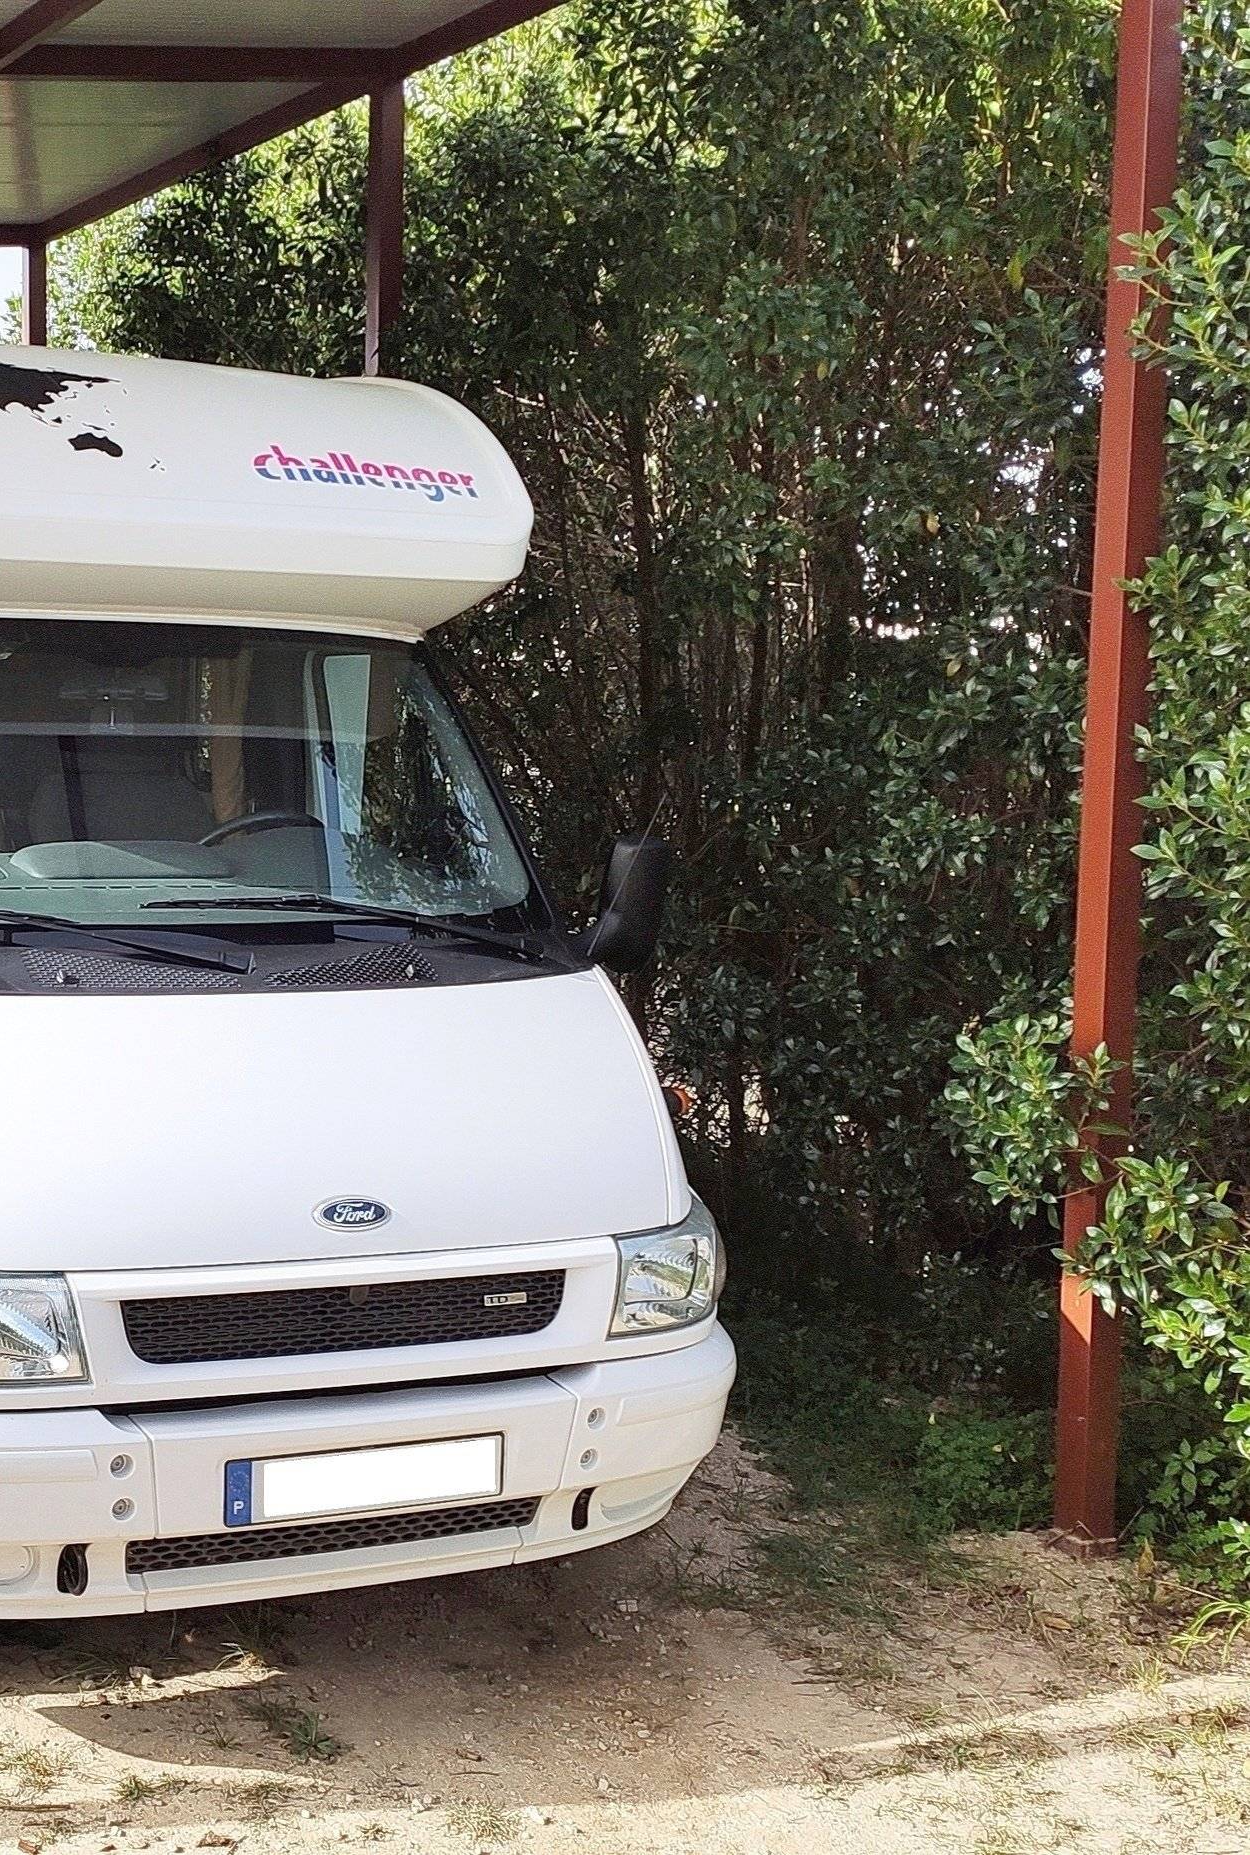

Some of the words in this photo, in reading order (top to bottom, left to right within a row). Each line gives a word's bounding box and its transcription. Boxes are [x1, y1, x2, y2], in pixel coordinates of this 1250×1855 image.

[253, 444, 479, 502] challenger
[333, 1202, 376, 1222] Ford
[233, 1500, 245, 1515] P
